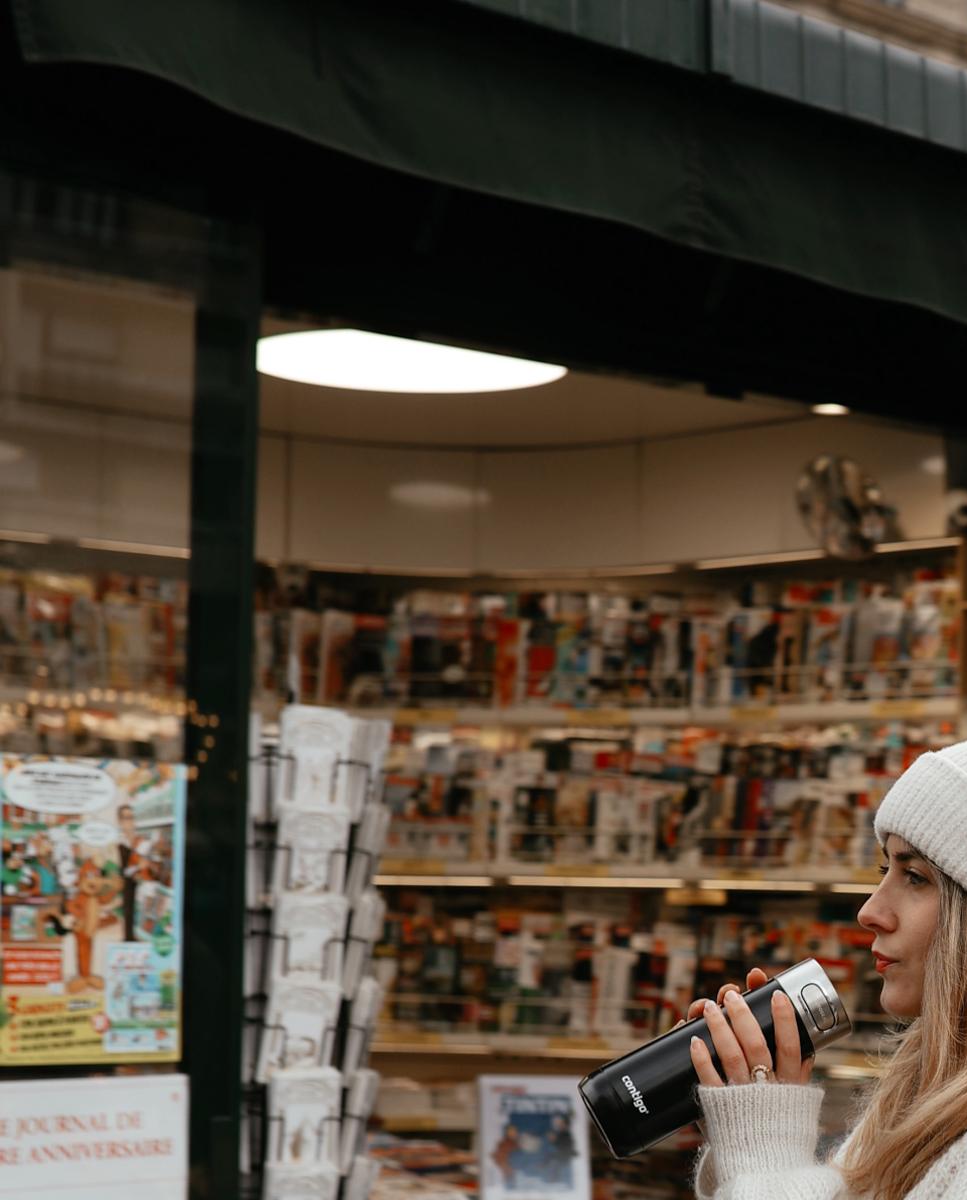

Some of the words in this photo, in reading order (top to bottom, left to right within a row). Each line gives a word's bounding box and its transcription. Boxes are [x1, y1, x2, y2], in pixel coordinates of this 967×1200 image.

[621, 1075, 648, 1114] contigo
[16, 1112, 109, 1140] JOURNAL
[116, 1111, 142, 1130] DE
[29, 1138, 174, 1164] ANNIVERSAIRE
